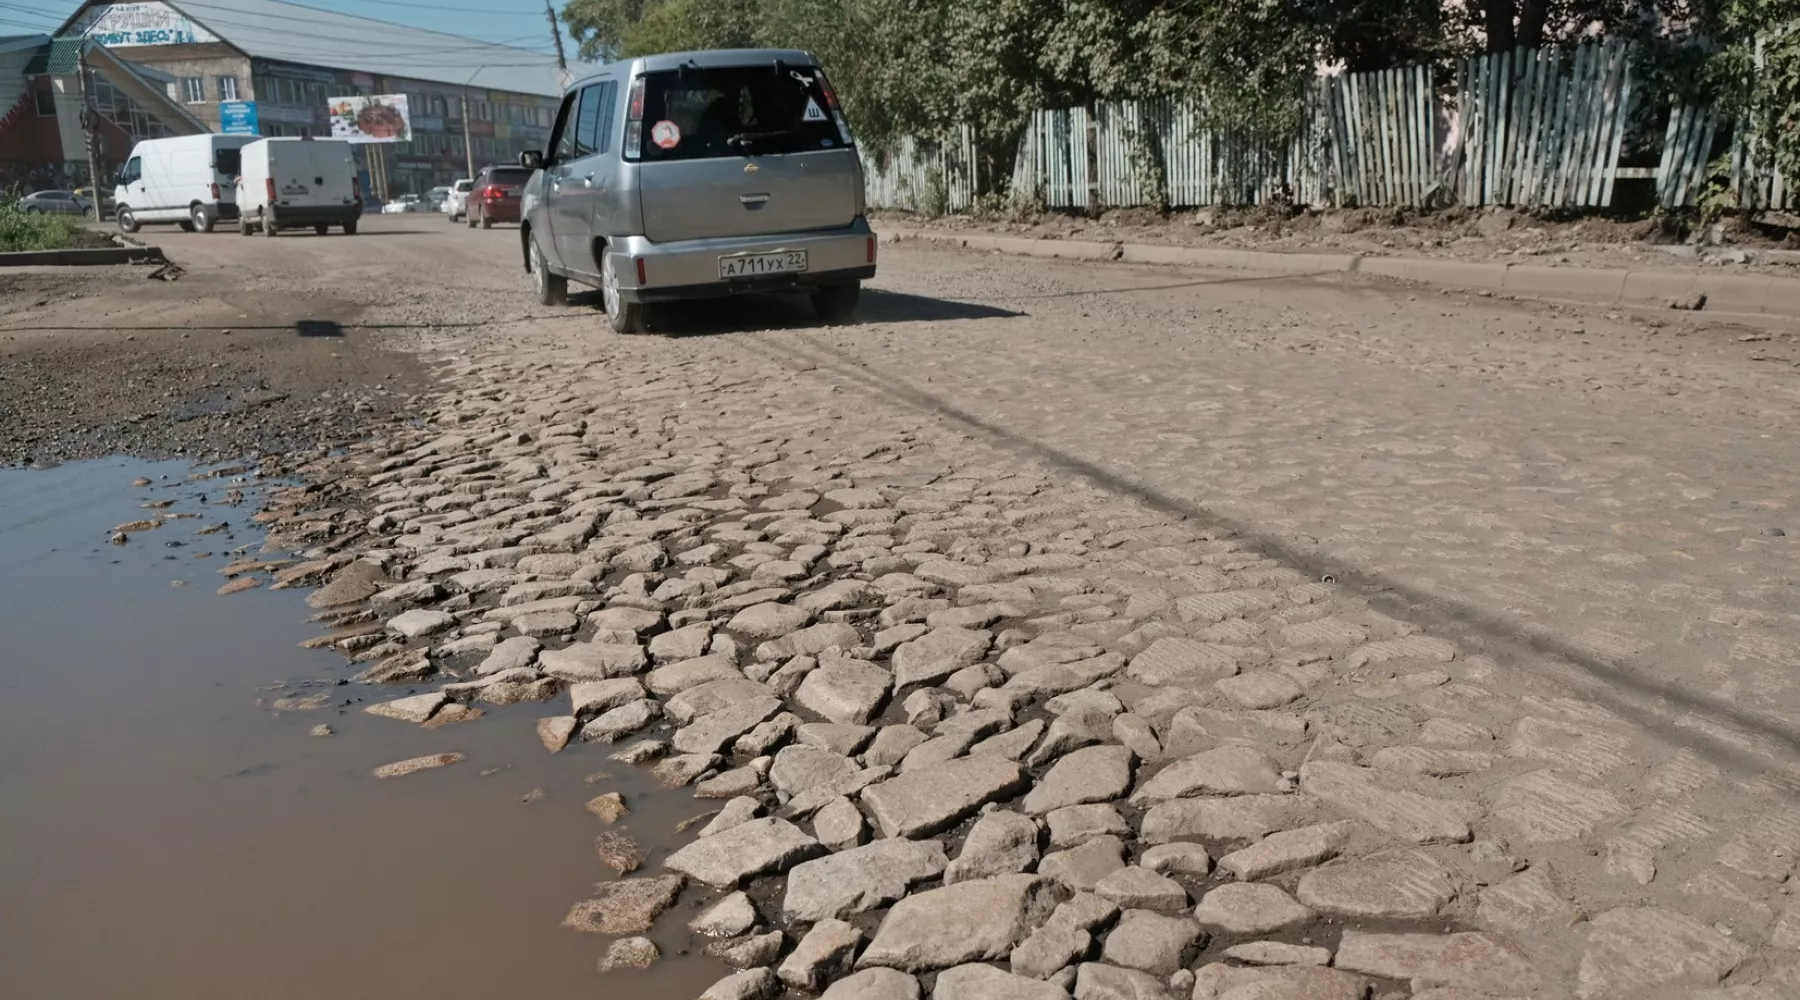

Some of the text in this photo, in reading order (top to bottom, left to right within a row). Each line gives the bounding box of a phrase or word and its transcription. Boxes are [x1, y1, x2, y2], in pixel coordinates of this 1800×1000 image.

[808, 107, 820, 118] Ш
[727, 253, 801, 275] А711УХ 22
